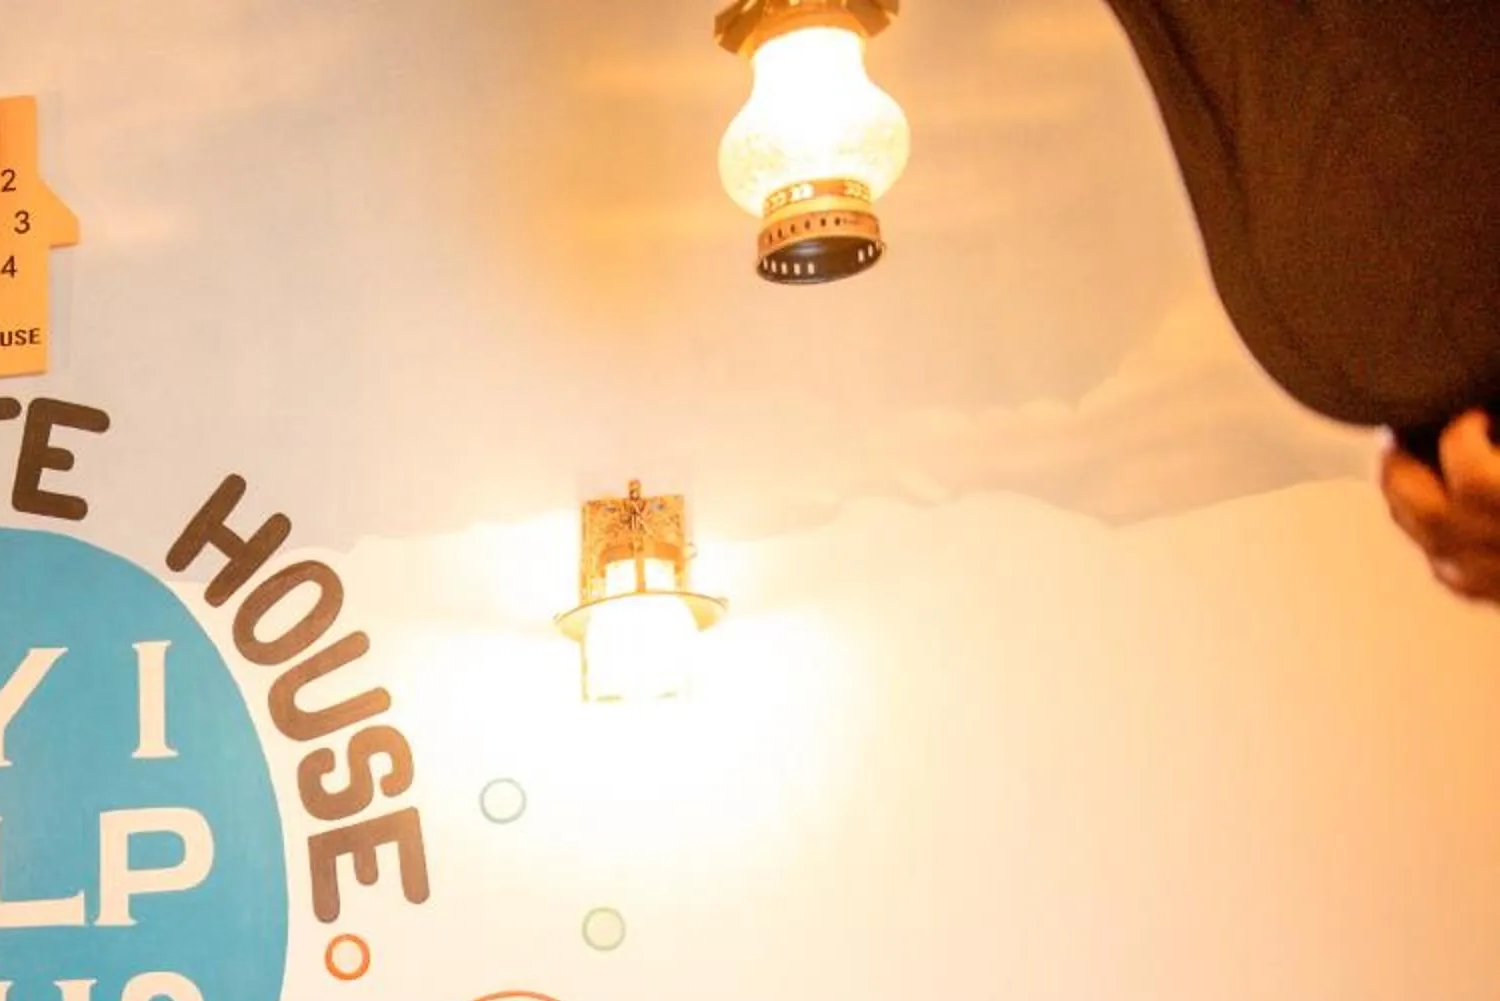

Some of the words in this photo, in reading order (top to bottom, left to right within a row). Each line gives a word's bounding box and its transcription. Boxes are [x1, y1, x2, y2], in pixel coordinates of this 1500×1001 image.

[0, 169, 17, 193] 2
[14, 210, 31, 235] 3
[0, 255, 18, 278] 4
[132, 640, 178, 760] I
[165, 473, 431, 924] HOUSE
